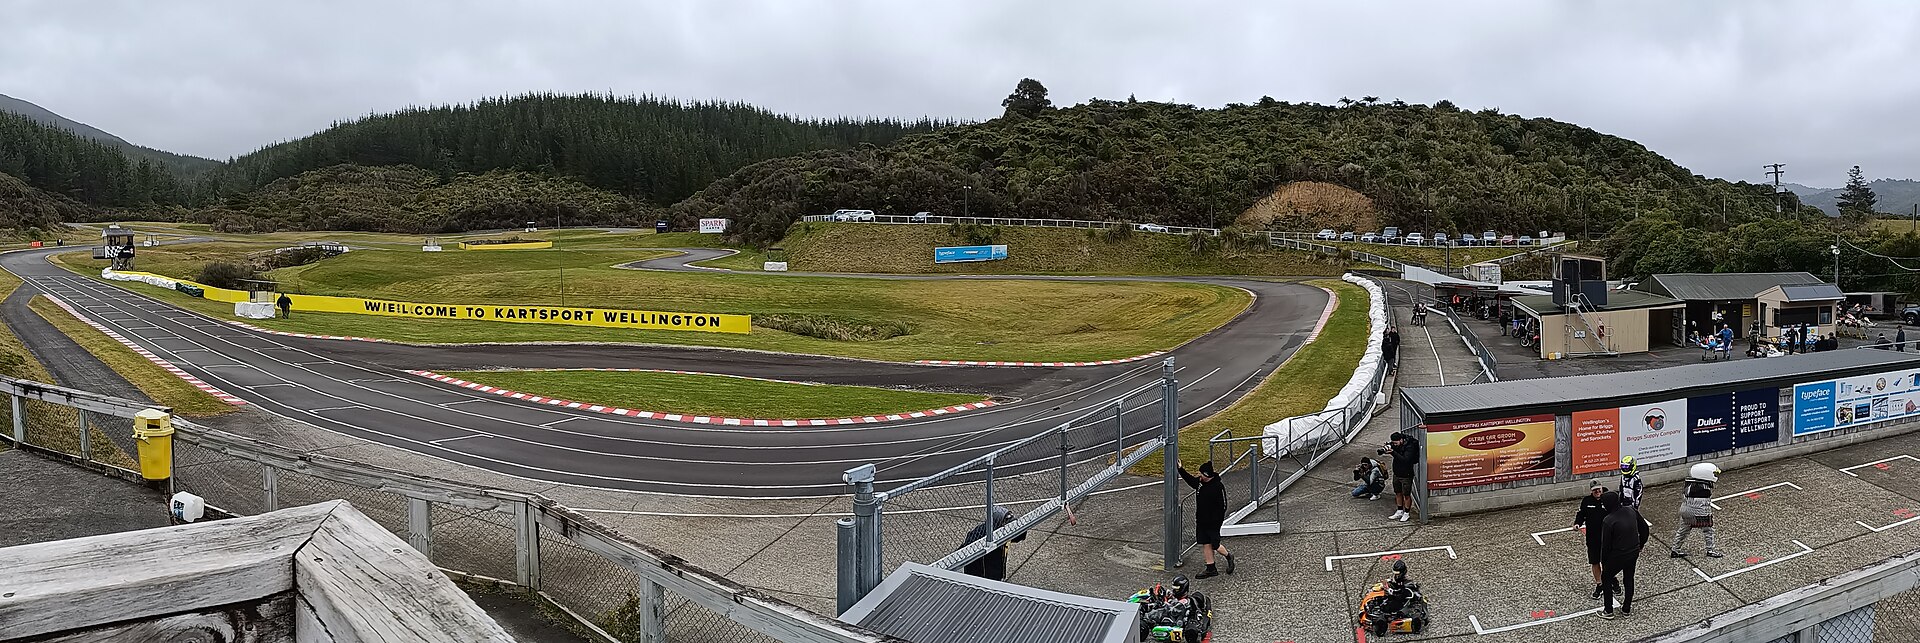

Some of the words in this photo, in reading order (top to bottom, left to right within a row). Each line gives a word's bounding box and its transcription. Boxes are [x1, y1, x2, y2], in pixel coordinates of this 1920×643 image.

[466, 307, 485, 318] TO
[495, 308, 594, 321] KARTSPORT
[603, 312, 720, 327] WELLINGTON
[1801, 389, 1830, 400] typeface
[1740, 404, 1758, 412] PROUD
[1740, 410, 1765, 419] SUPPORT
[1697, 417, 1723, 427] Dulux
[1740, 416, 1771, 426] KARTSPORT
[1740, 422, 1775, 433] WELLINGTON
[1660, 429, 1681, 437] Company
